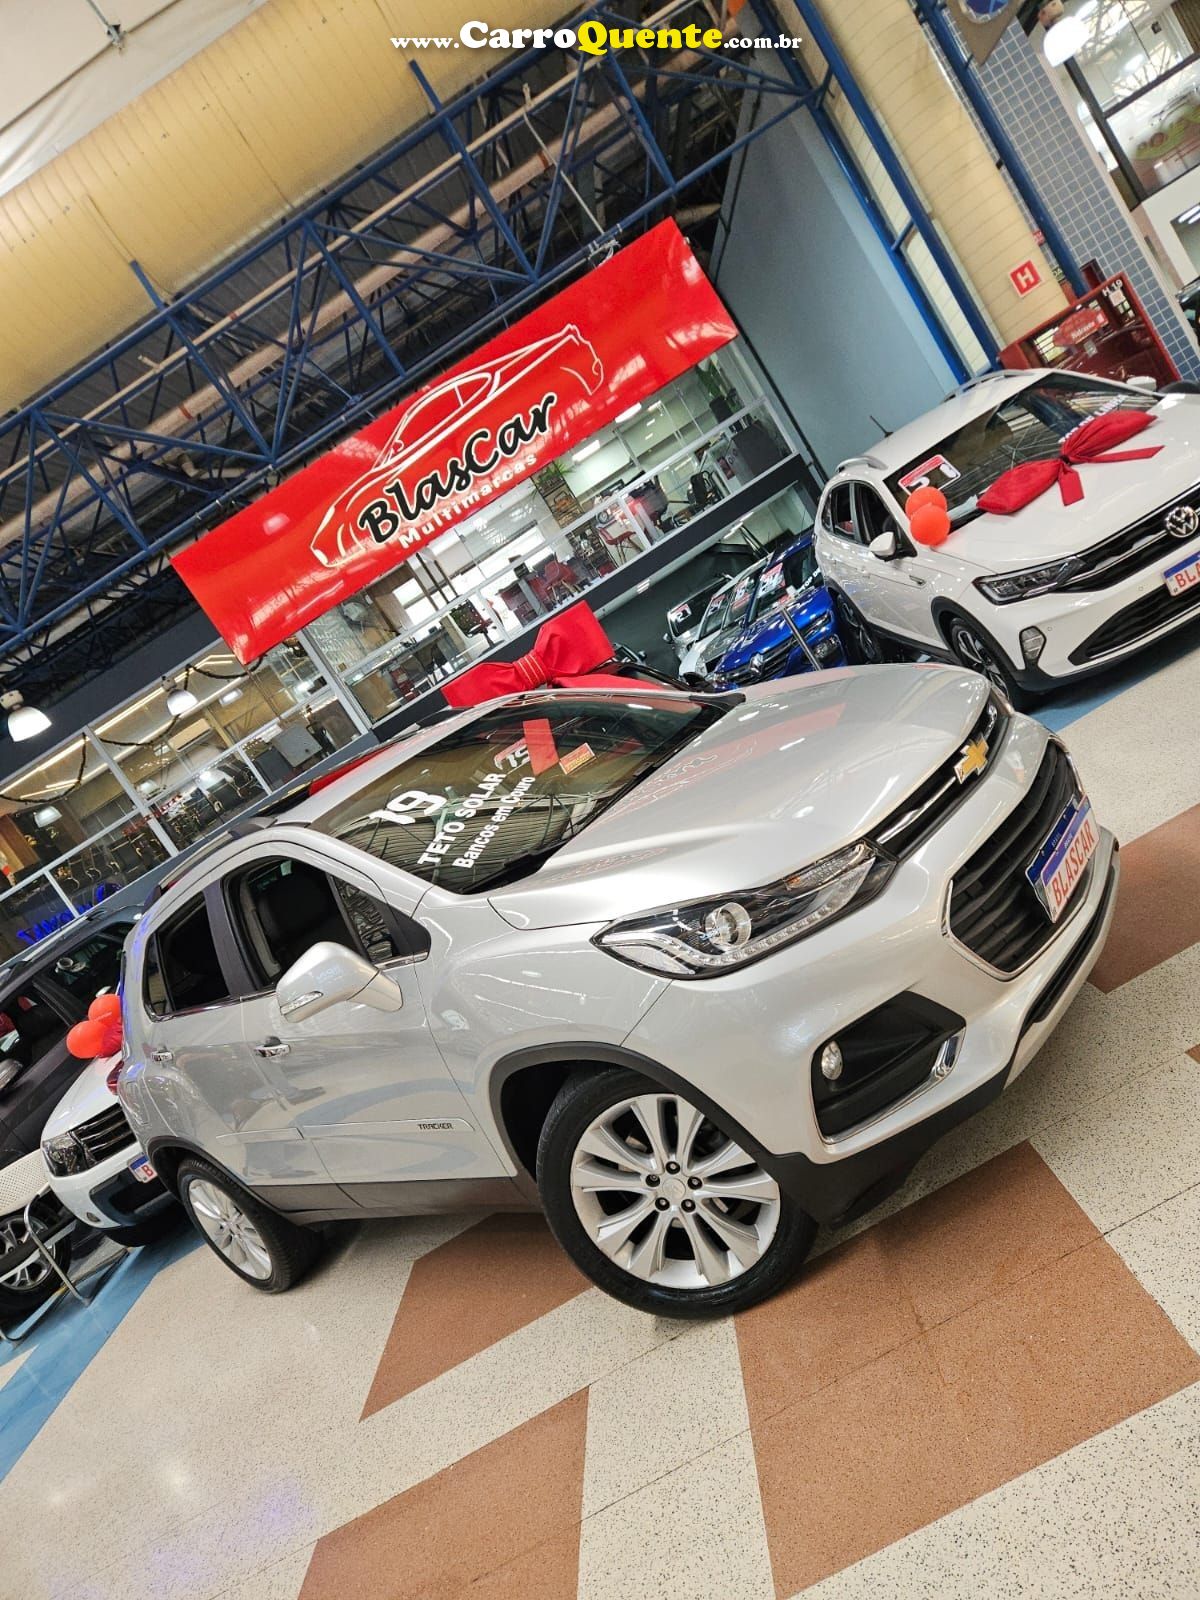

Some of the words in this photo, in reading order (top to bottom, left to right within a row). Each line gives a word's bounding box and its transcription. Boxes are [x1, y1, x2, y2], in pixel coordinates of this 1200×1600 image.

[1016, 266, 1036, 289] H
[358, 393, 557, 544] BlasCar
[400, 453, 537, 549] Multimarcas
[368, 789, 447, 825] 19
[491, 801, 514, 823] em
[500, 776, 536, 807] Couro
[417, 821, 465, 866] TETO
[455, 772, 506, 819] SOLAR
[452, 823, 500, 868] Bancos
[1051, 818, 1095, 906] BLASCAR
